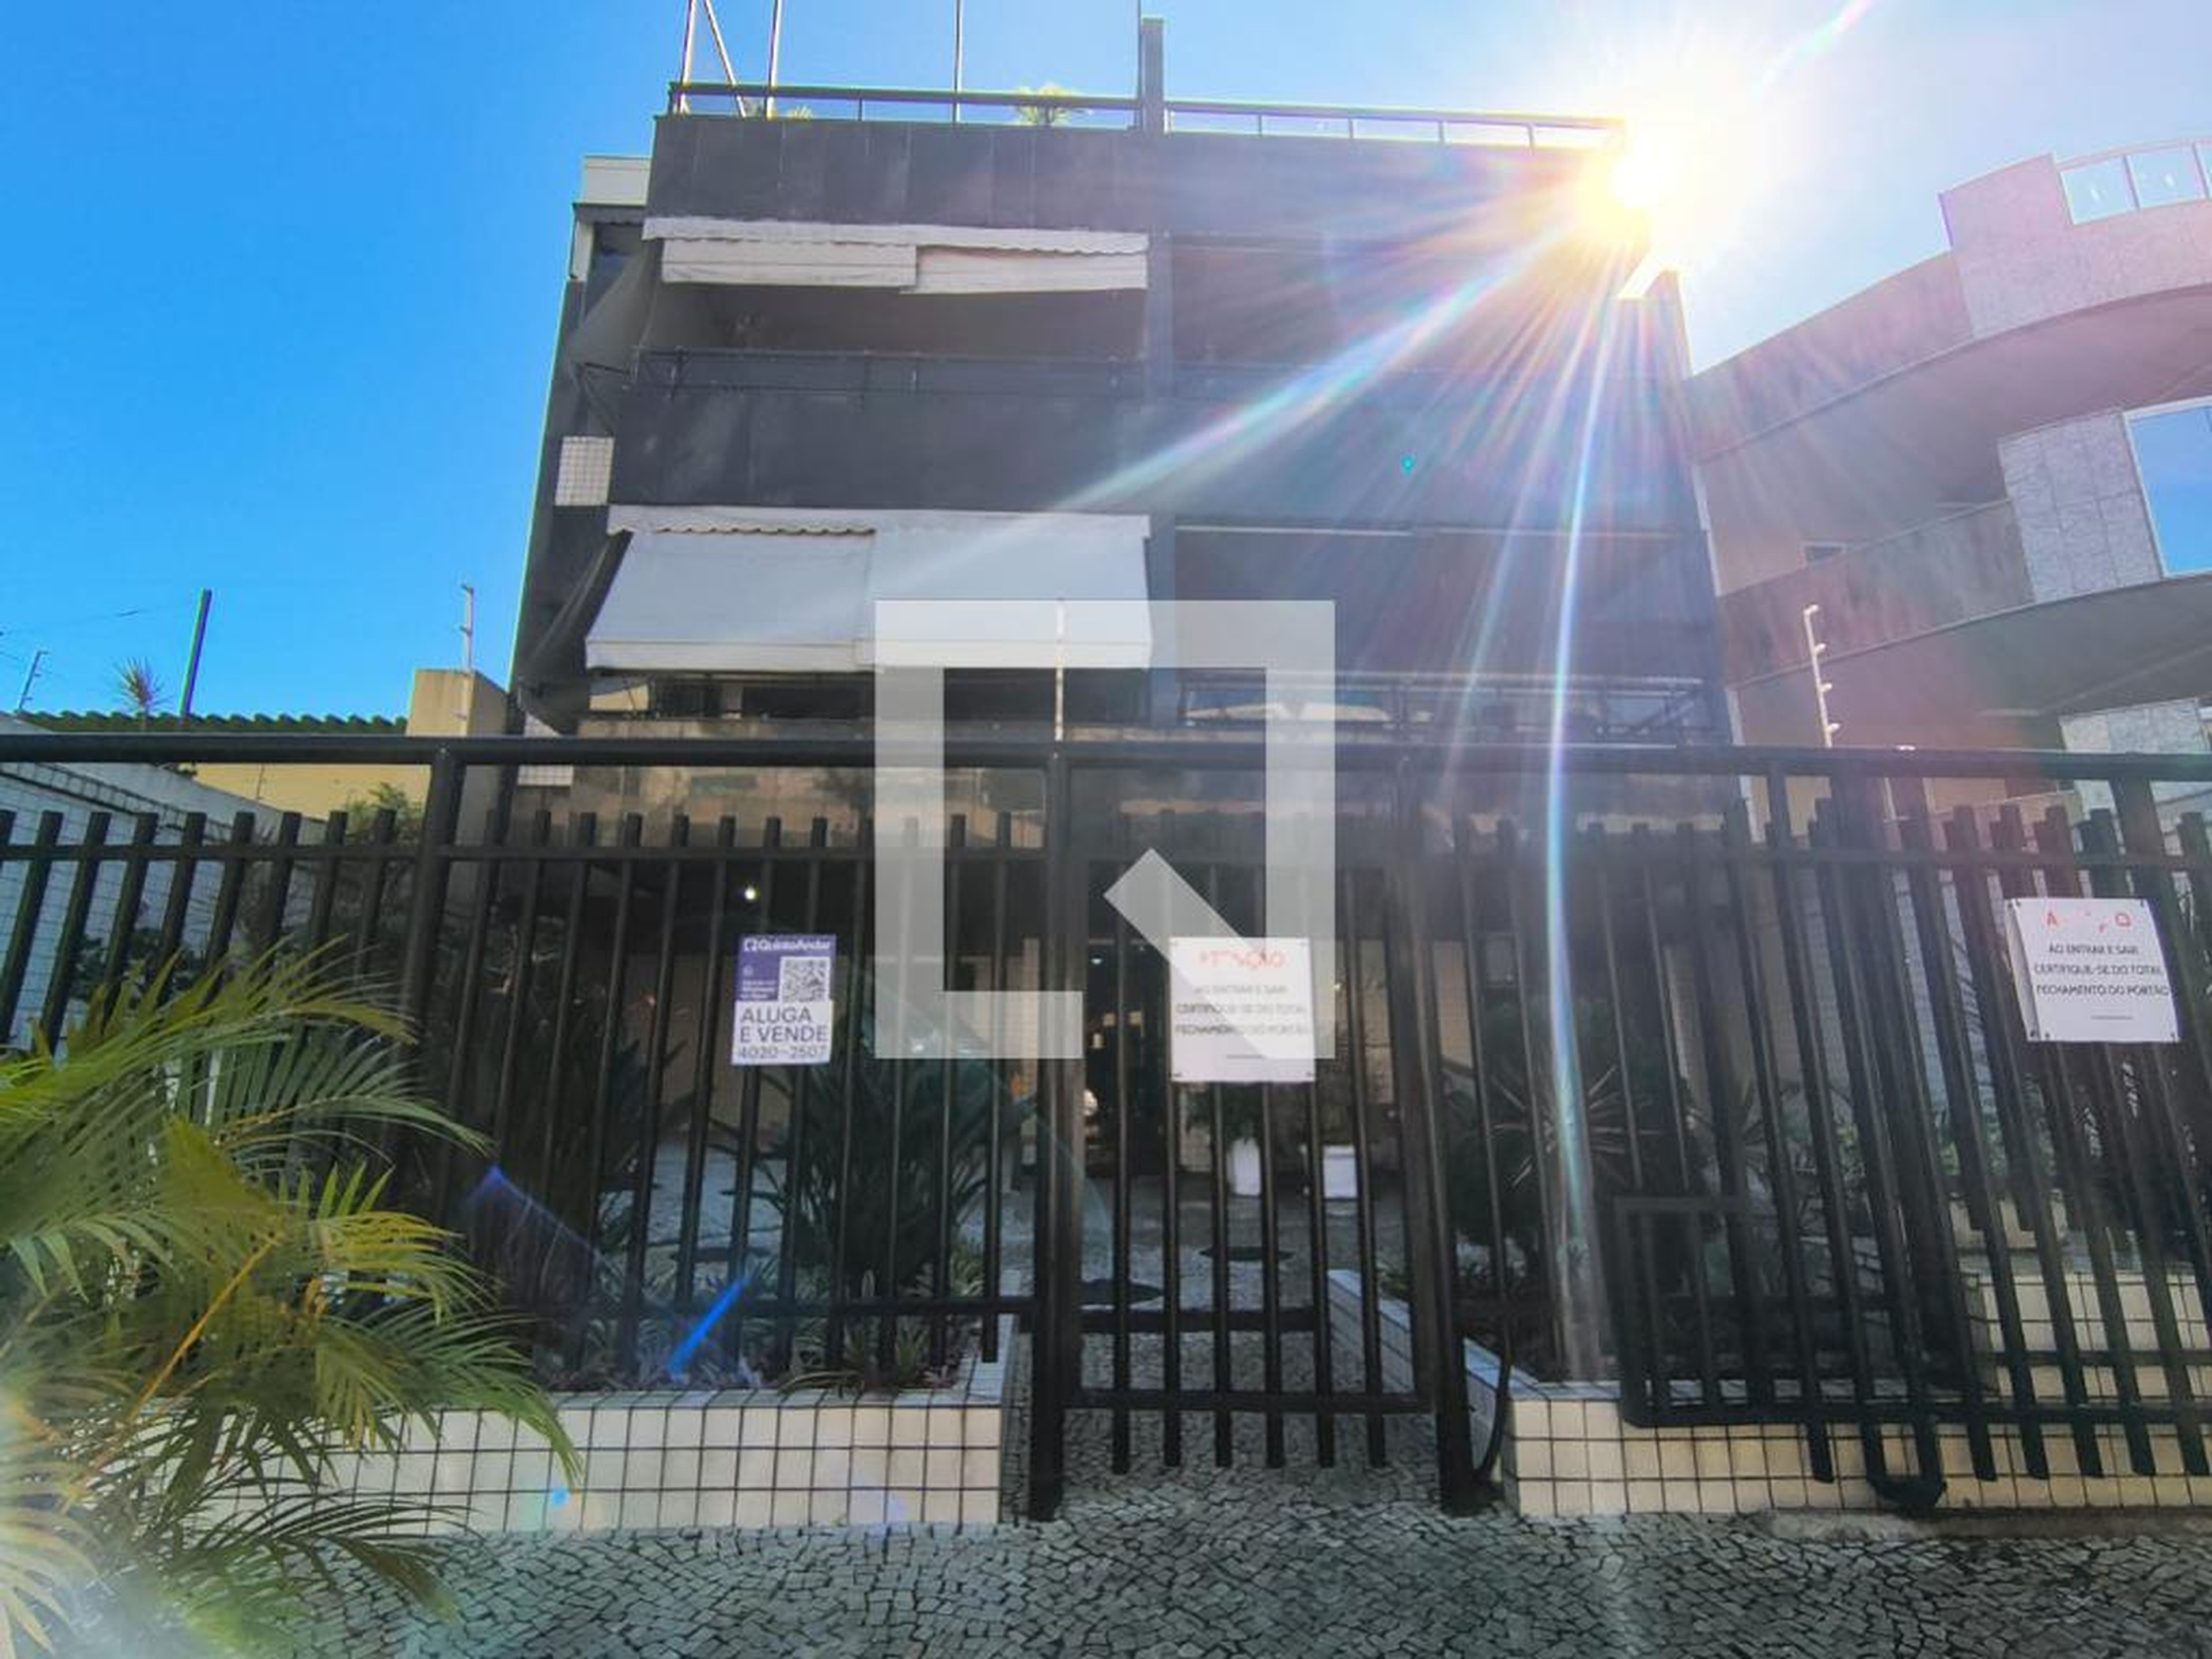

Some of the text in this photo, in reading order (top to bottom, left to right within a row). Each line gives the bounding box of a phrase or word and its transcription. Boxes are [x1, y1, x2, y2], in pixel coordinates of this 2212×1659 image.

[741, 1006, 812, 1024] ALUGA
[740, 1024, 828, 1043] E VENDE
